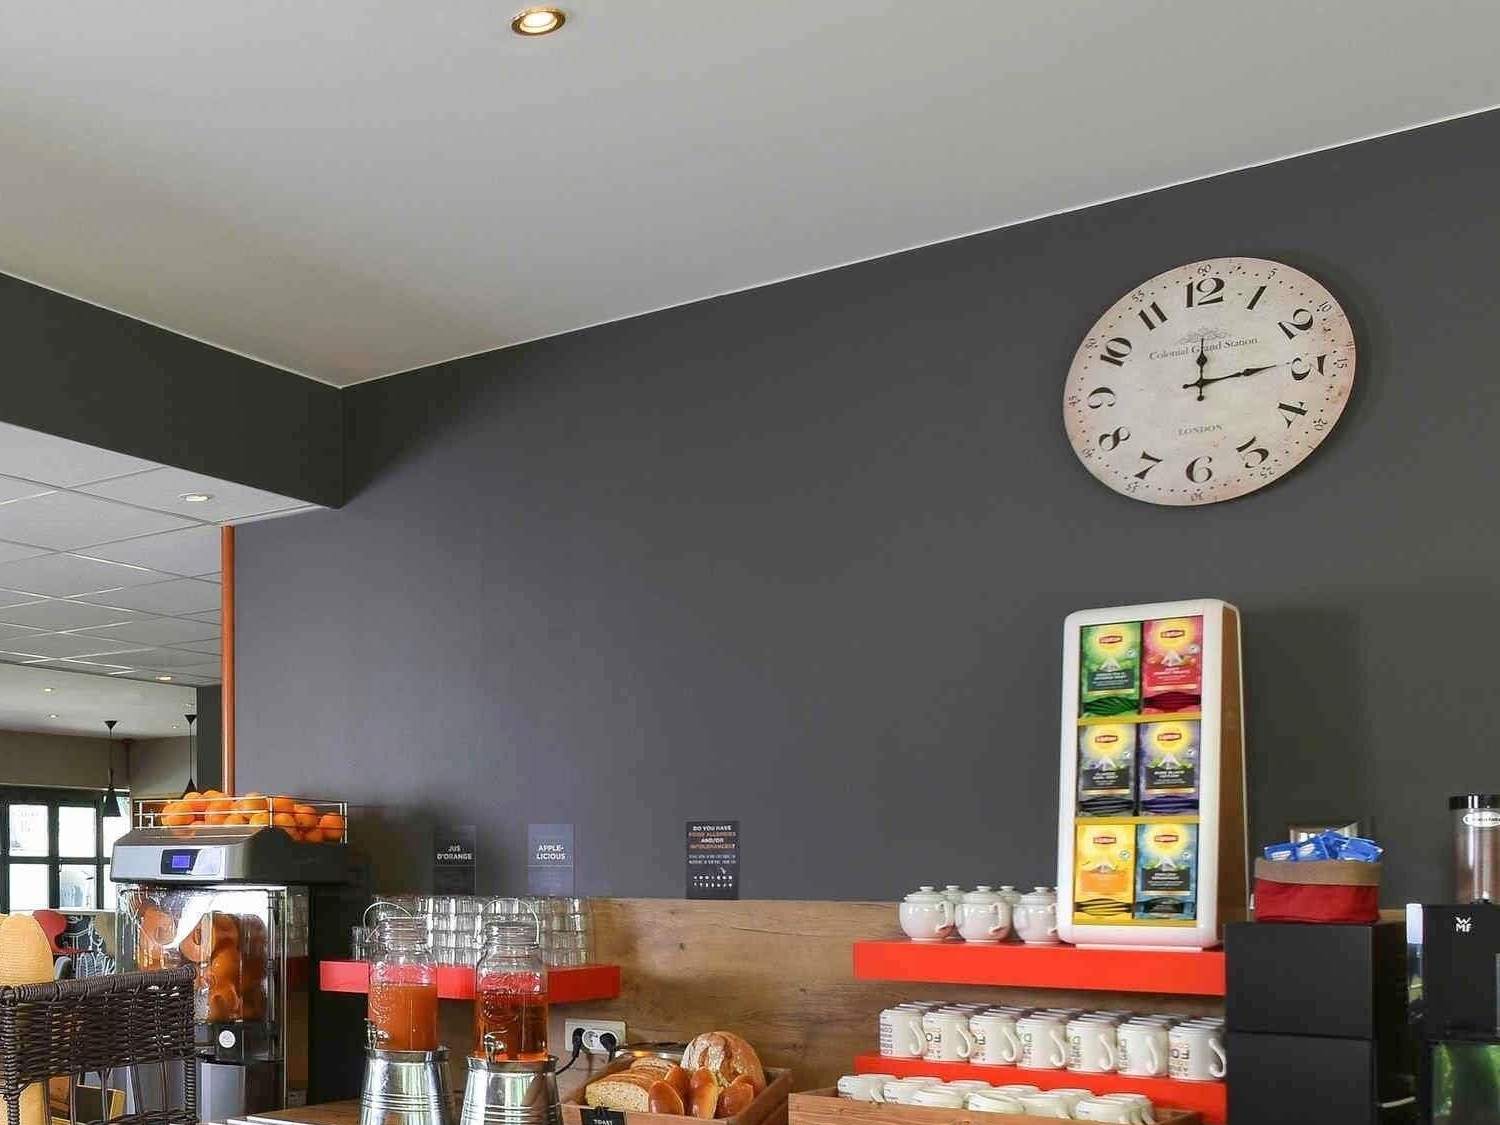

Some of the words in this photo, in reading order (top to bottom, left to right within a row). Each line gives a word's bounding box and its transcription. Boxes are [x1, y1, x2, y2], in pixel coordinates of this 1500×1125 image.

[1186, 277, 1225, 308] 12
[1247, 286, 1268, 310] 1
[1138, 302, 1168, 330] 11
[1278, 309, 1313, 340] 2
[1100, 337, 1132, 367] 10
[1149, 346, 1189, 361] Colonial
[1225, 337, 1258, 350] Station
[1291, 354, 1327, 381] 3
[1087, 387, 1116, 409] 9
[1278, 401, 1308, 428] 4
[1099, 426, 1131, 451] 8
[1178, 424, 1223, 436] LONDON
[1134, 451, 1163, 480] 7
[1236, 436, 1269, 468] 5
[1186, 456, 1212, 483] 6
[1455, 917, 1471, 932] WMF
